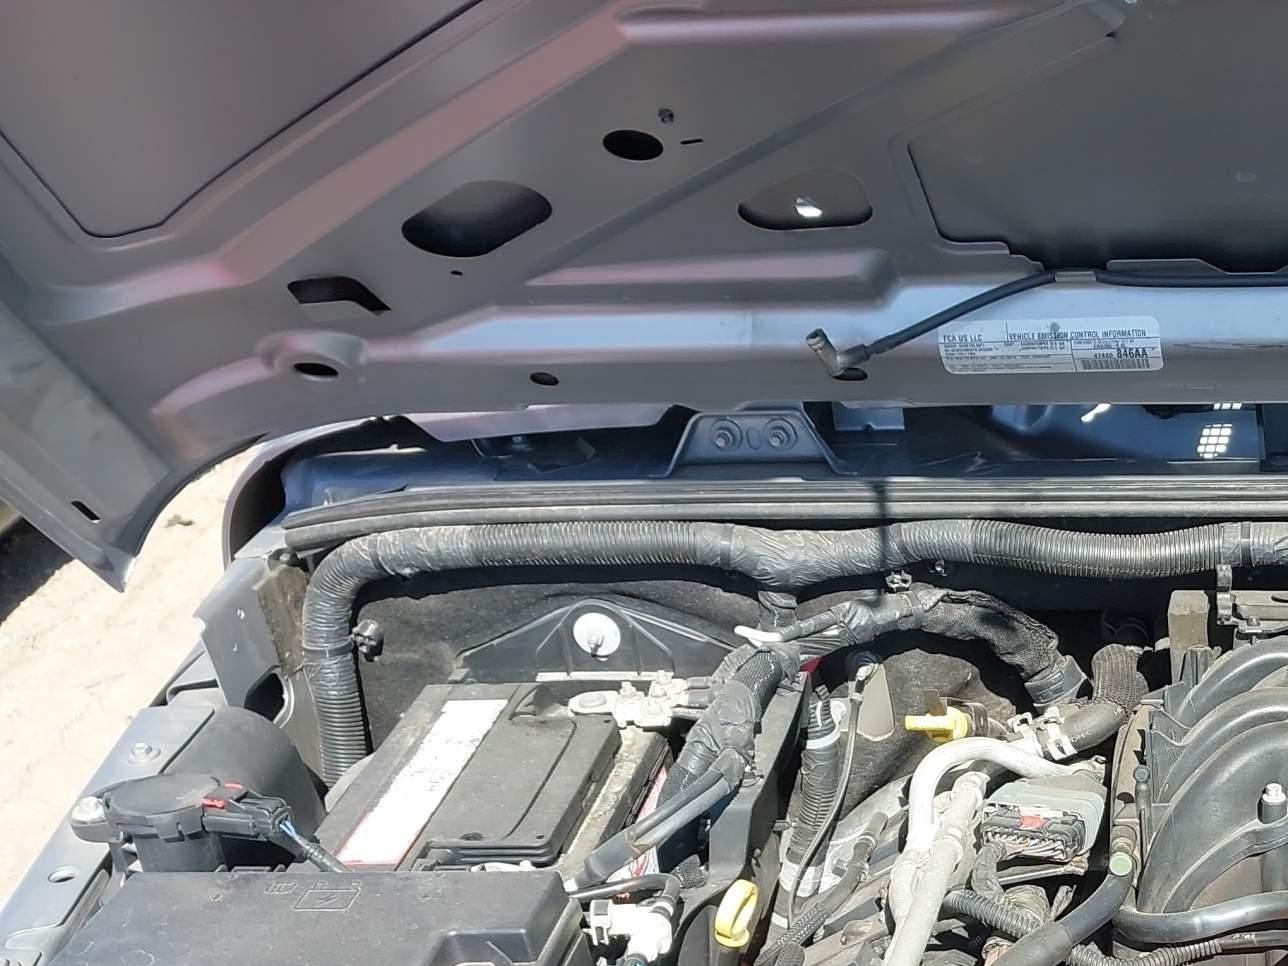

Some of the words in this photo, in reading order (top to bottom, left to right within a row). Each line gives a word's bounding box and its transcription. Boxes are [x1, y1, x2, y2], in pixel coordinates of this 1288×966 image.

[943, 334, 957, 343] FCA
[958, 334, 968, 342] US
[969, 333, 983, 342] LLC
[1008, 332, 1036, 341] VEHICLE
[1037, 330, 1069, 340] EMISSION
[1070, 330, 1100, 339] CONTROL
[1101, 328, 1147, 338] INFORMATION
[1116, 347, 1149, 358] 846AA
